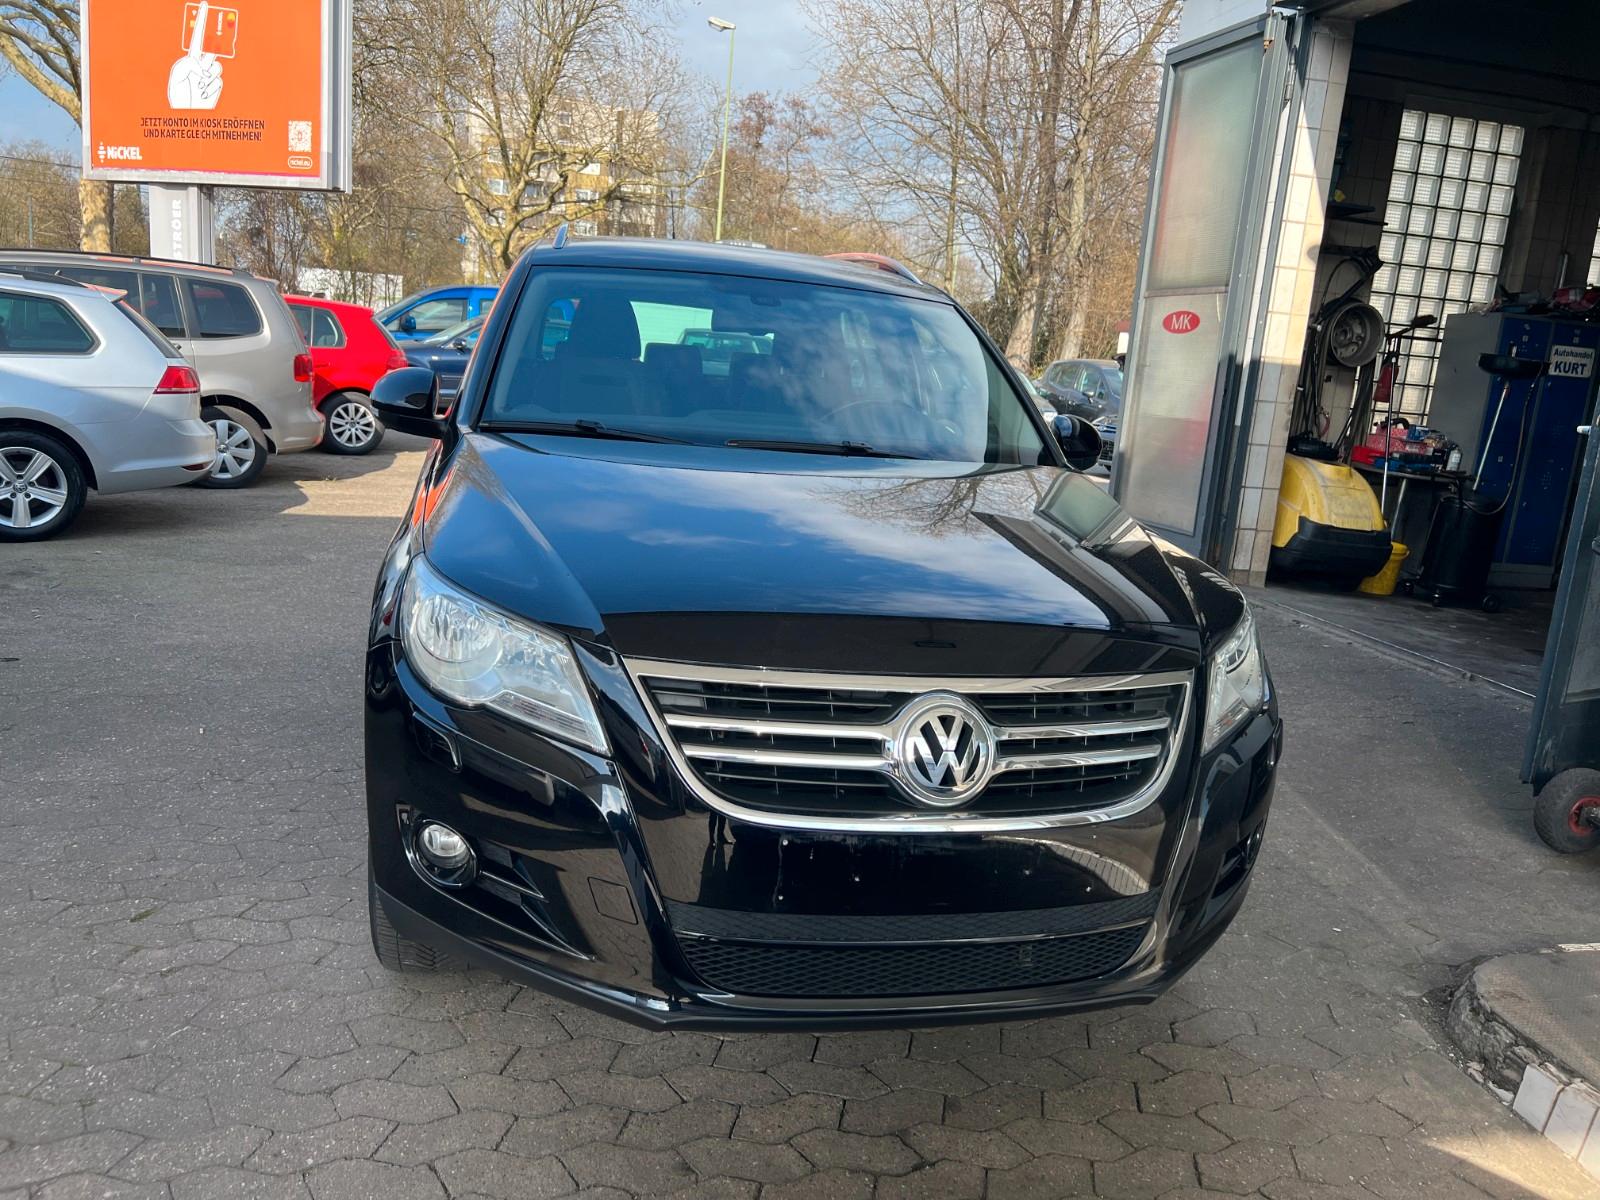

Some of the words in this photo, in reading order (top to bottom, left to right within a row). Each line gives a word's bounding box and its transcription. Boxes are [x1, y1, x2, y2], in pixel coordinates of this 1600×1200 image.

[140, 117, 162, 127] JETZT
[162, 117, 189, 127] KONTO
[200, 118, 222, 128] KIOSK
[224, 116, 265, 130] ERÖFFNEN
[143, 128, 159, 138] UND
[160, 128, 185, 139] KARTE
[212, 130, 262, 141] MITNEHMEN!
[1170, 313, 1193, 330] MK
[1553, 361, 1588, 376] KURT
[904, 704, 988, 798] VW
